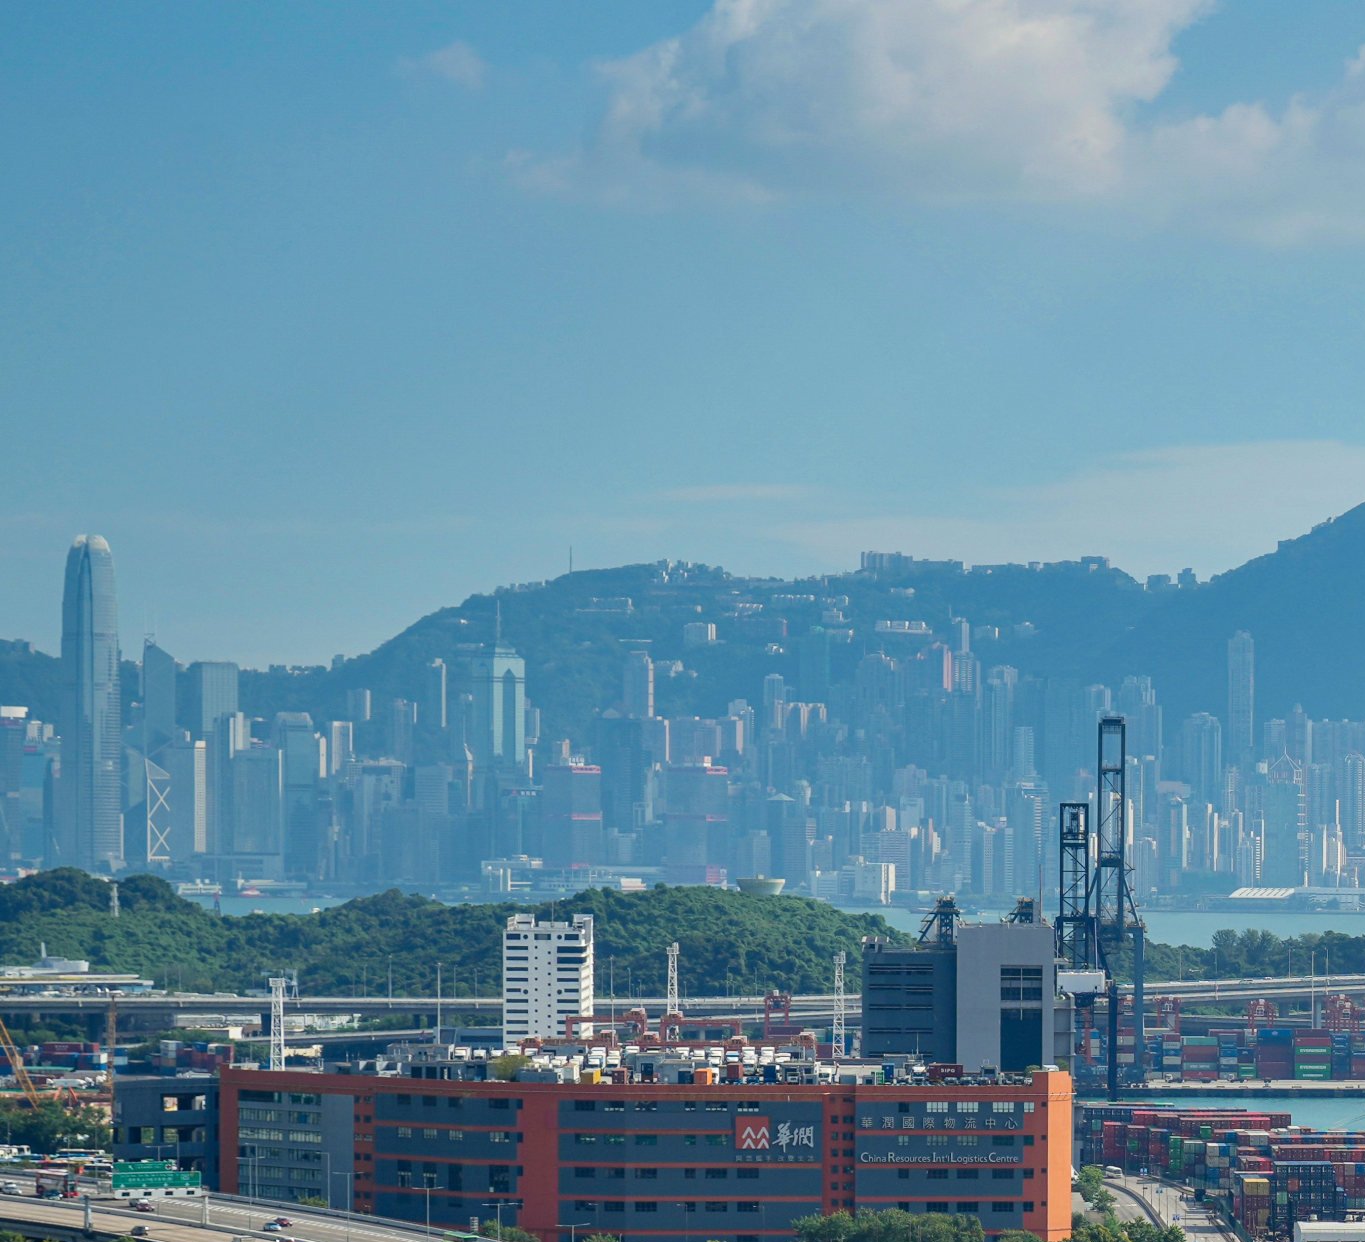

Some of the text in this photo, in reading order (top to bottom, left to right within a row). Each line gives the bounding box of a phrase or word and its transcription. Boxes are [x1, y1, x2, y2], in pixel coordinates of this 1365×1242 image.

[860, 1117, 1018, 1129] 華潤國際物流中心
[860, 1152, 887, 1163] China
[888, 1152, 930, 1163] Resources
[950, 1152, 987, 1166] Logistics
[988, 1152, 1018, 1163] Centre
